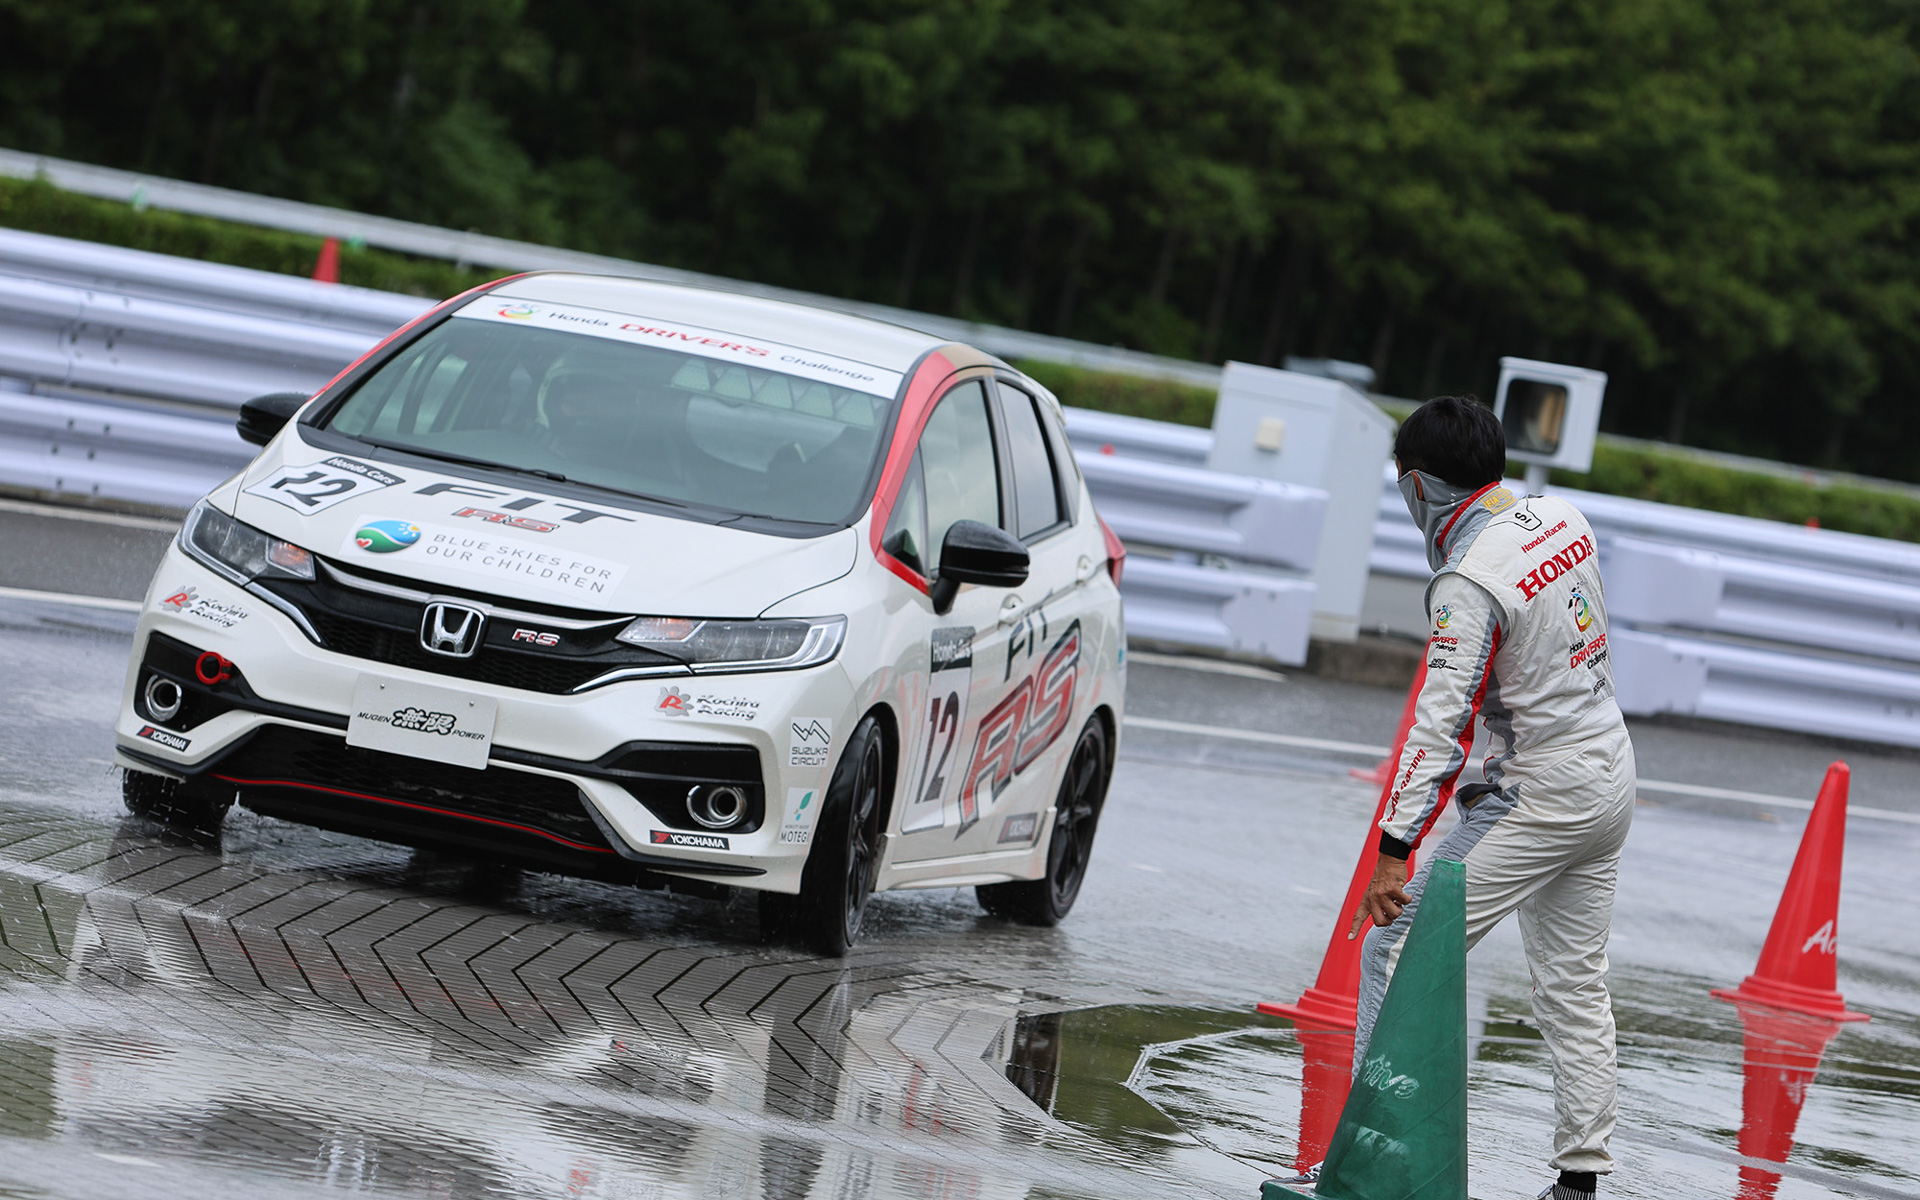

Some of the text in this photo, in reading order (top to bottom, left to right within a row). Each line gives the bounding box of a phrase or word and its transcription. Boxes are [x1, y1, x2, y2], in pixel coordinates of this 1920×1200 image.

[548, 311, 609, 327] Honda
[779, 354, 875, 383] Challenge
[327, 457, 396, 485] Honda Cars
[269, 470, 357, 507] 12
[412, 481, 638, 525] FIT
[451, 506, 560, 533] RS
[1521, 520, 1568, 554] Honda Racing
[426, 545, 605, 593] OUR CHILDREN
[433, 533, 612, 580] BLUE SKIES FOR
[1515, 534, 1595, 602] HONDA
[512, 628, 560, 647] RS
[357, 710, 391, 723] MUGEN
[452, 728, 486, 742] POWER
[698, 705, 756, 721] Racing
[956, 618, 1082, 840] RS
[151, 729, 188, 749] YOKOHAMA
[791, 746, 829, 756] SUZUKA
[915, 691, 959, 804] 12
[791, 757, 826, 766] CIRCUIT
[670, 834, 726, 849] YOKOHAMA
[780, 830, 811, 843] MOTEGI
